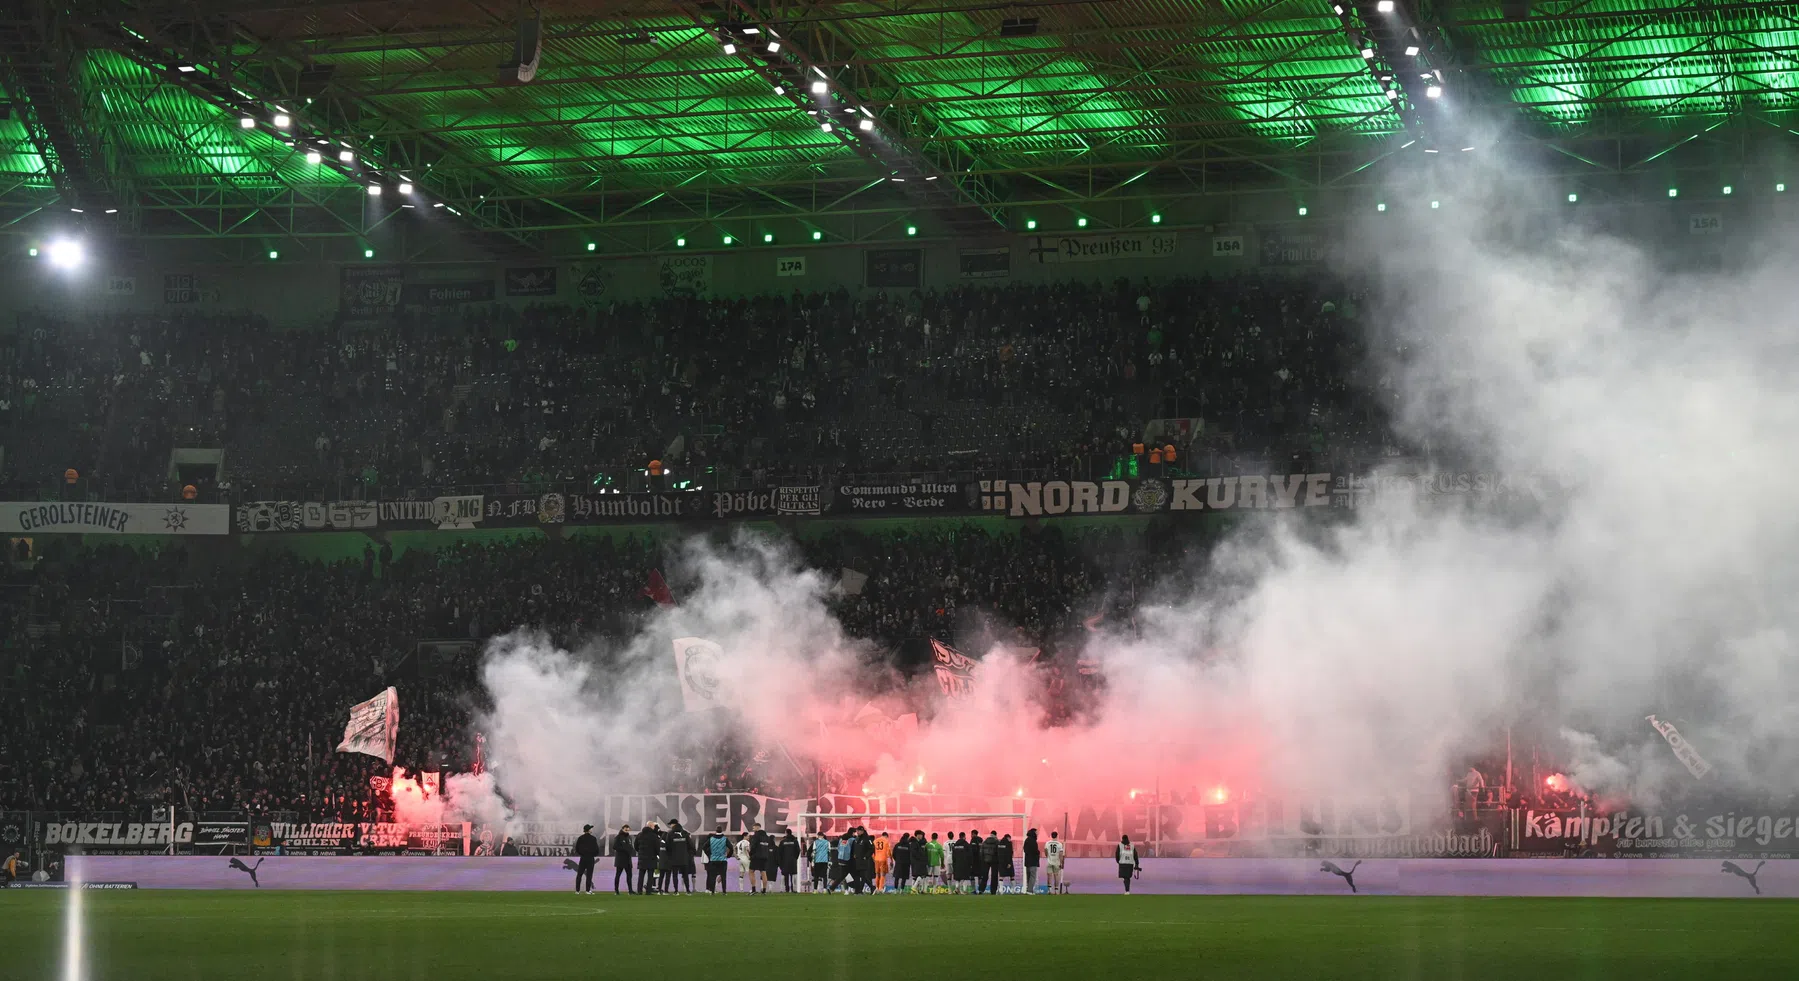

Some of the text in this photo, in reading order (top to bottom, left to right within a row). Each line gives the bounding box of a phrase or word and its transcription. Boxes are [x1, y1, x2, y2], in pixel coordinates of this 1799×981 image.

[1692, 217, 1719, 229] 15A
[1059, 235, 1143, 259] Preußen
[1215, 241, 1240, 252] 16A
[666, 256, 706, 268] LOCOS
[779, 260, 803, 272] 17A
[779, 486, 819, 495] RISPETTO
[840, 483, 957, 496] Commando Ultra
[1009, 479, 1130, 517] NORD
[1170, 472, 1331, 511] KURVE
[712, 488, 777, 518] Pöbel
[780, 492, 818, 502] PER GLI
[852, 497, 886, 509] Nero
[903, 495, 945, 508] Verde
[380, 499, 435, 521] UNITED
[457, 498, 480, 518] MG
[571, 494, 683, 520] Humboldt
[779, 501, 818, 510] ULTRAS
[19, 503, 130, 533] GEROLSTEINER
[608, 793, 789, 834] UNSERE
[45, 820, 194, 845] BÖKELBERG
[270, 821, 355, 839] WILLICHER
[1524, 809, 1799, 846] kämpfen & siege
[876, 841, 884, 850] 33
[1049, 843, 1057, 854] 16
